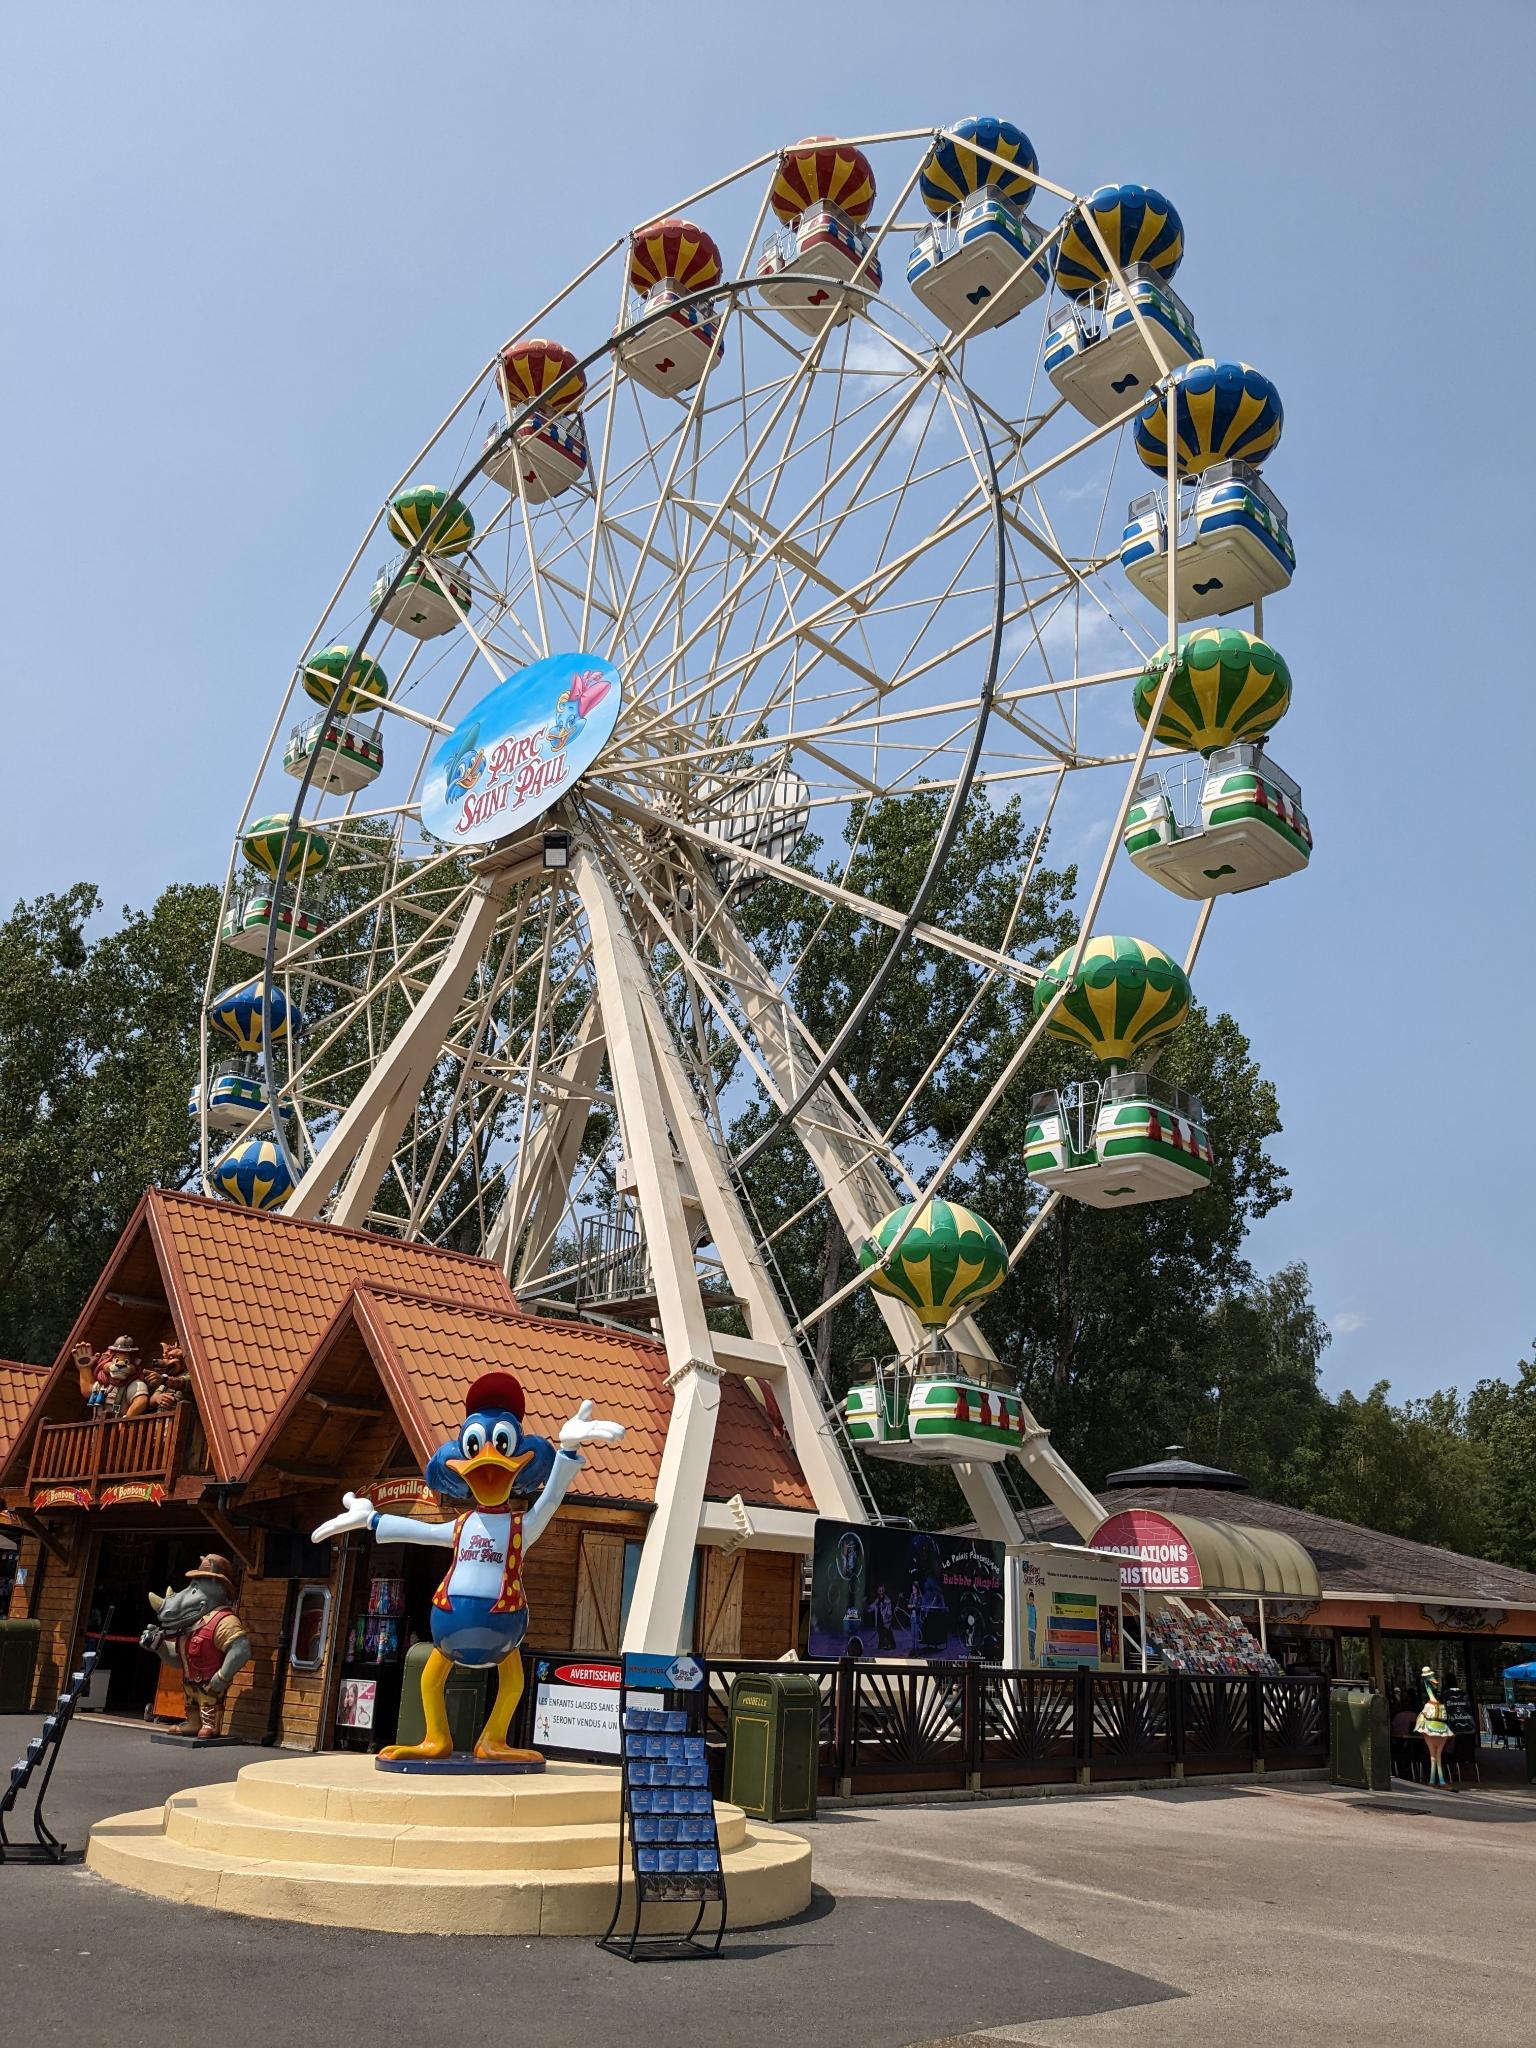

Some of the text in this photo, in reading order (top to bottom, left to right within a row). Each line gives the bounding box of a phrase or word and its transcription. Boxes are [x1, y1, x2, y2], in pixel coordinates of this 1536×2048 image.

[486, 727, 546, 787] PARC
[456, 753, 568, 832] SAINT PAUL
[50, 1490, 75, 1501] Bonbons
[119, 1486, 146, 1498] Bonbons
[469, 1535, 495, 1549] PARC
[1120, 1566, 1189, 1584] RISTIQUES
[570, 1668, 622, 1682] AVERTISSEME
[538, 1697, 548, 1706] LES
[549, 1698, 575, 1709] ENFANTS
[575, 1700, 598, 1711] LAISSES
[598, 1701, 614, 1712] SANS
[552, 1715, 618, 1731] SERONT VENDUS A UN
